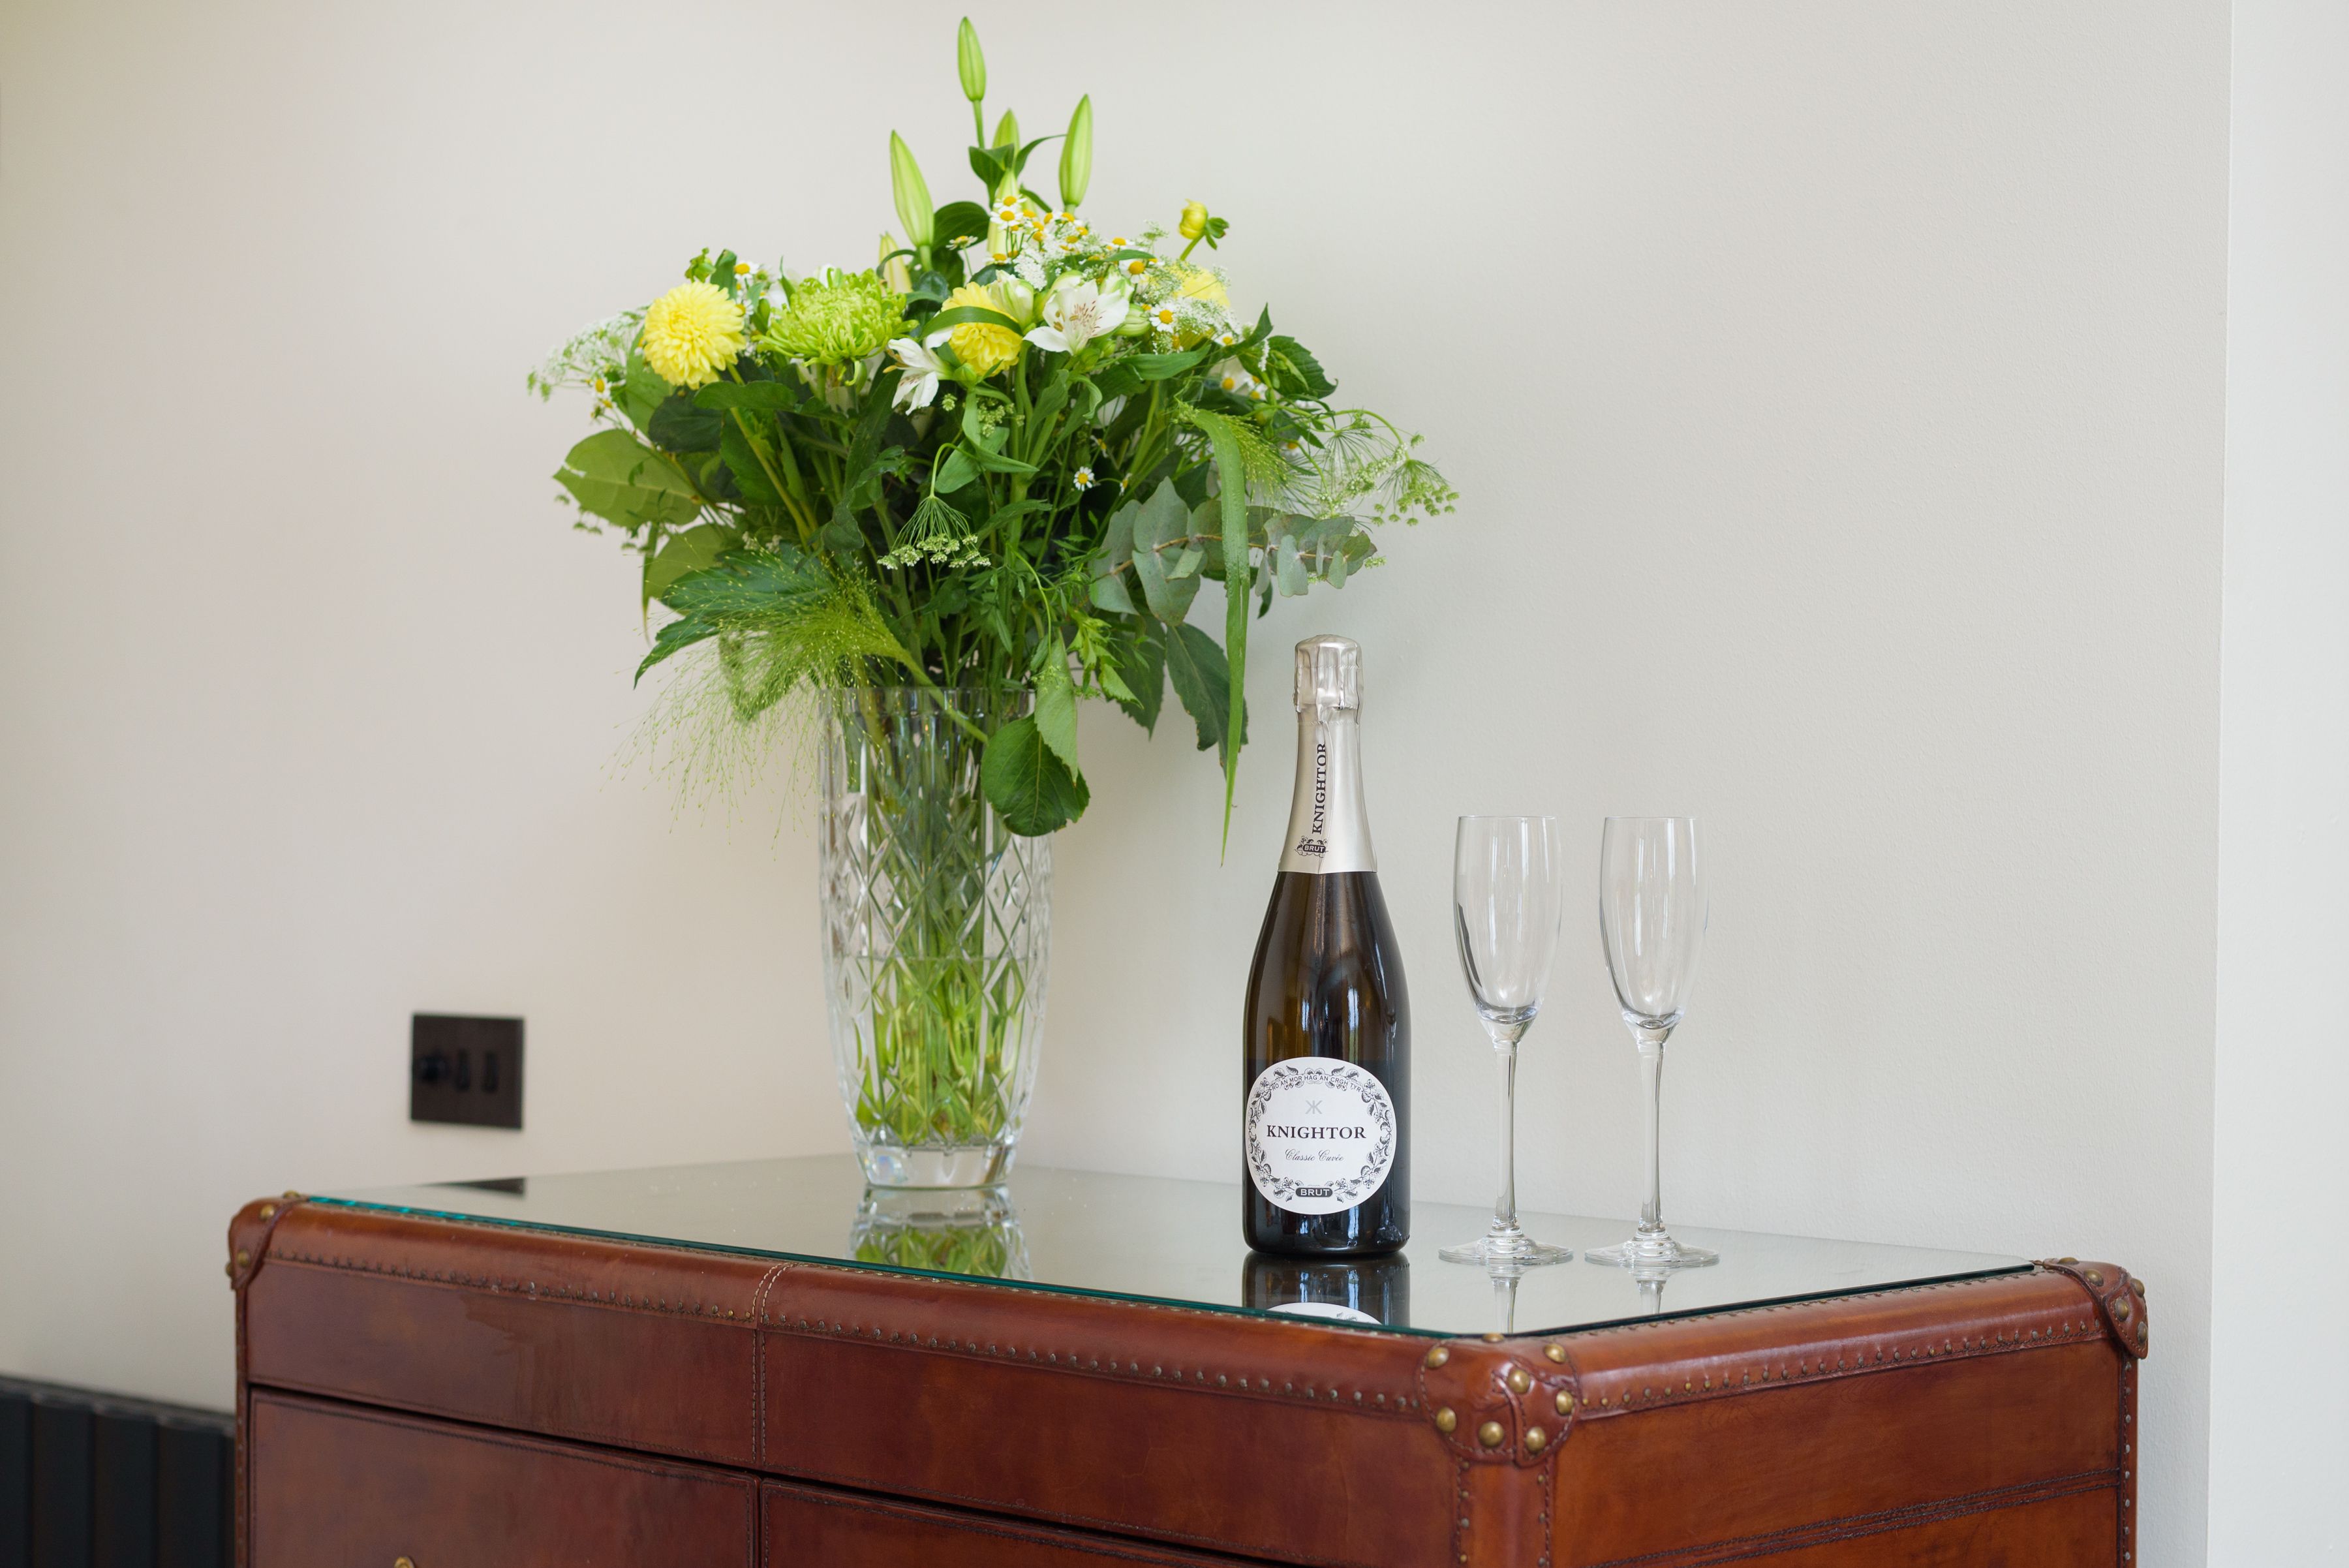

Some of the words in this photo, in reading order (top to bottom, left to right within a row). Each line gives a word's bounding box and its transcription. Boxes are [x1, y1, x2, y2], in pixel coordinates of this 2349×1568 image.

[1312, 743, 1327, 835] KNIGHTOR
[1266, 1124, 1367, 1140] KNIGHTOR
[1284, 1148, 1315, 1161] Classic
[1300, 1188, 1330, 1197] BRUT
